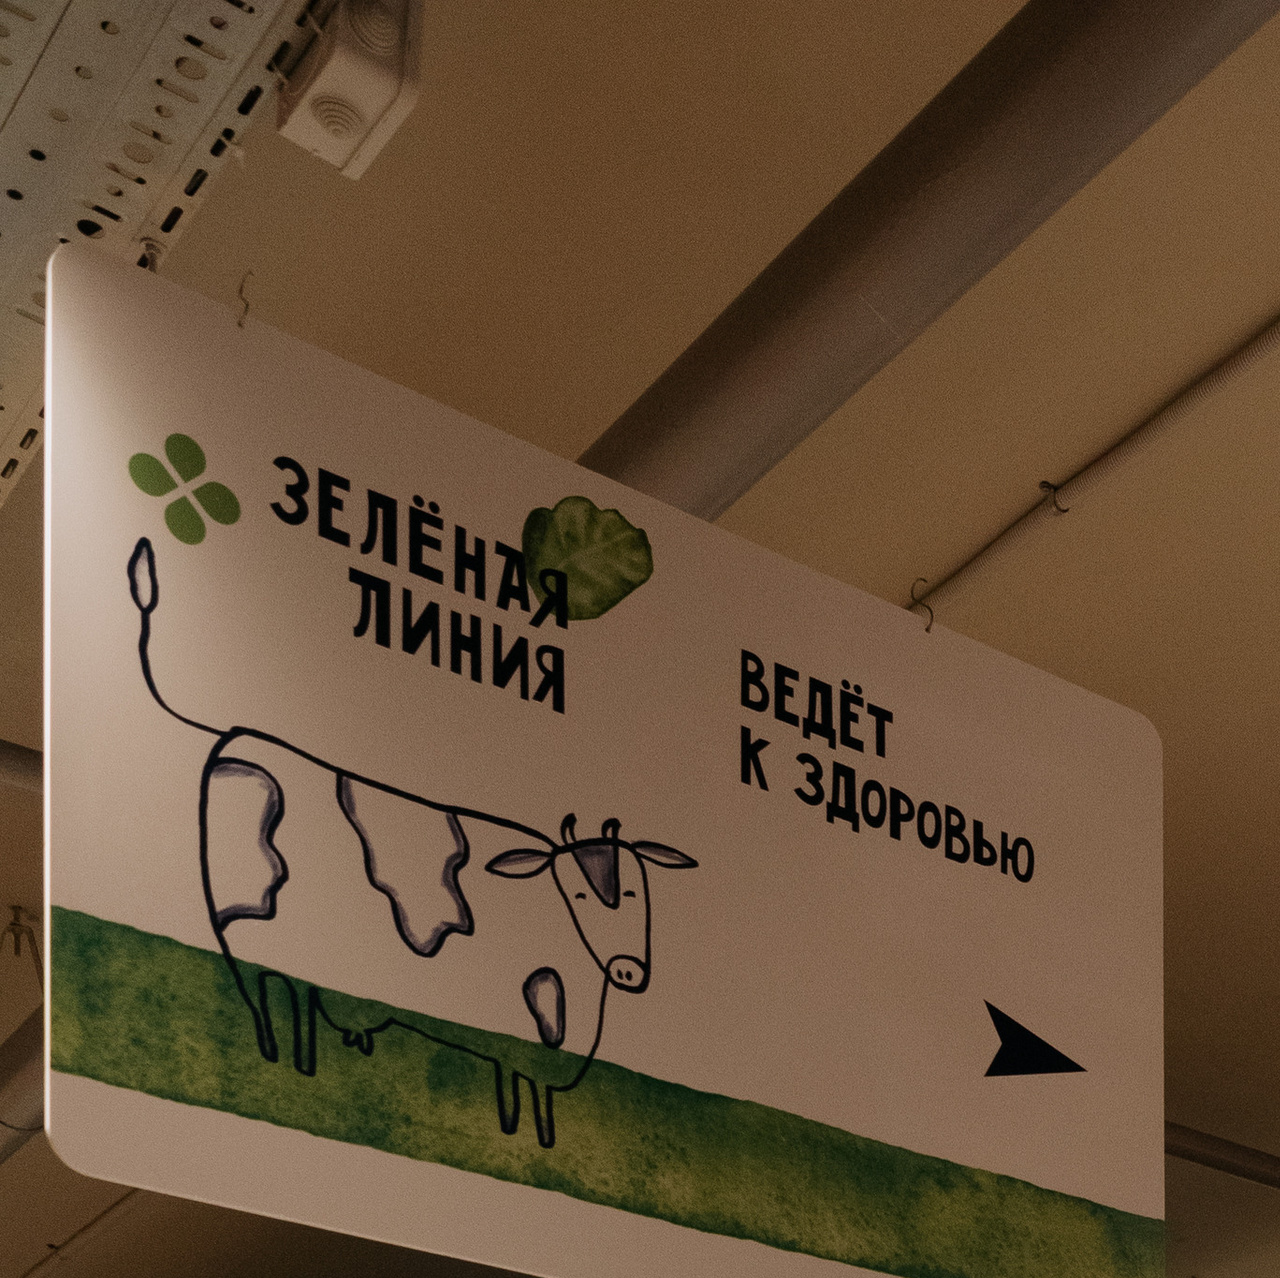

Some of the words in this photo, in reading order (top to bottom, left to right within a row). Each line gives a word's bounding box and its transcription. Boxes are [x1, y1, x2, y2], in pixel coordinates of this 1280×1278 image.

[270, 456, 569, 630] ЗЕЛЁНАЯ
[348, 566, 566, 714] ЛИНИЯ
[740, 648, 894, 758] ВЕДЁТ
[740, 725, 771, 792] К
[793, 752, 1035, 883] ЗДОРОВЬЮ
